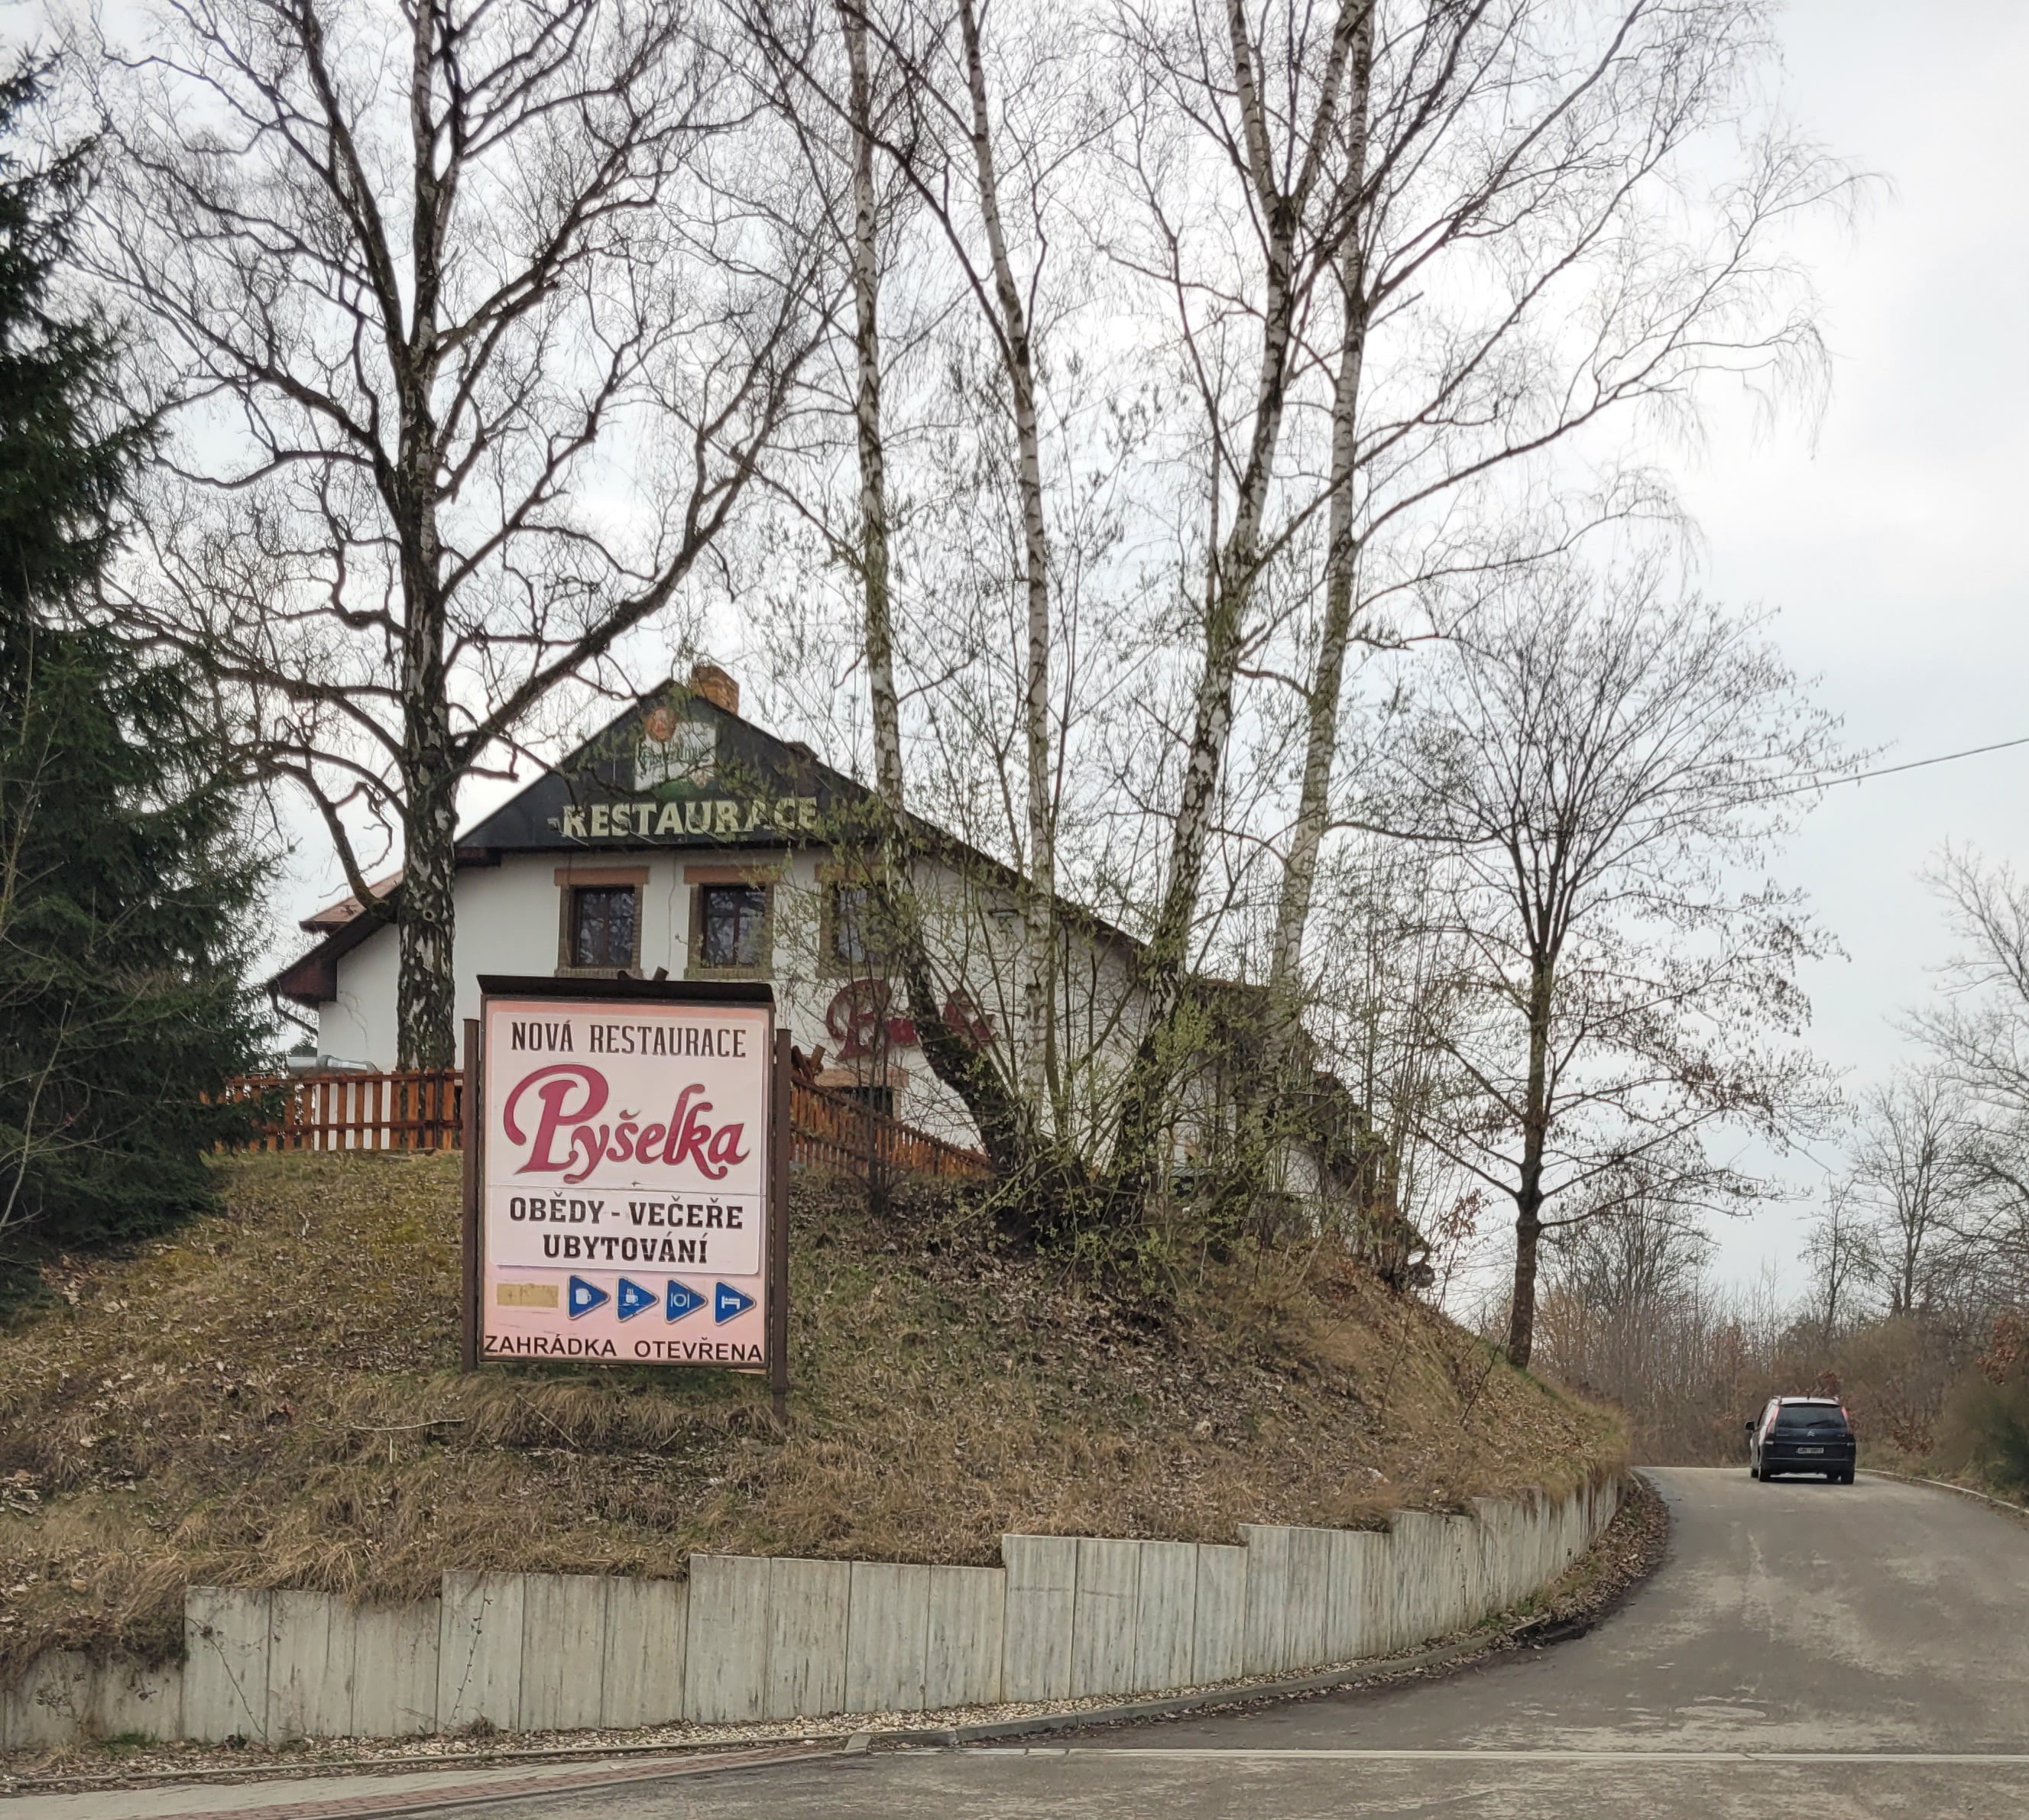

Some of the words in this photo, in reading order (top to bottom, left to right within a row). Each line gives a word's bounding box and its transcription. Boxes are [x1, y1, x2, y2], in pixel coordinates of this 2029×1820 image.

[562, 796, 817, 837] RESTAURACE
[510, 1019, 575, 1053] NOVÁ
[589, 1024, 747, 1058] RESTAURACE
[503, 1063, 750, 1185] Pyšelka
[509, 1191, 605, 1223] OBĚDY
[628, 1195, 744, 1230] VEČEŘE
[543, 1231, 708, 1265] UBYTOVÁNÍ
[484, 1333, 617, 1357] ZAHRÁDKA
[634, 1336, 763, 1362] OTEVŘENA
